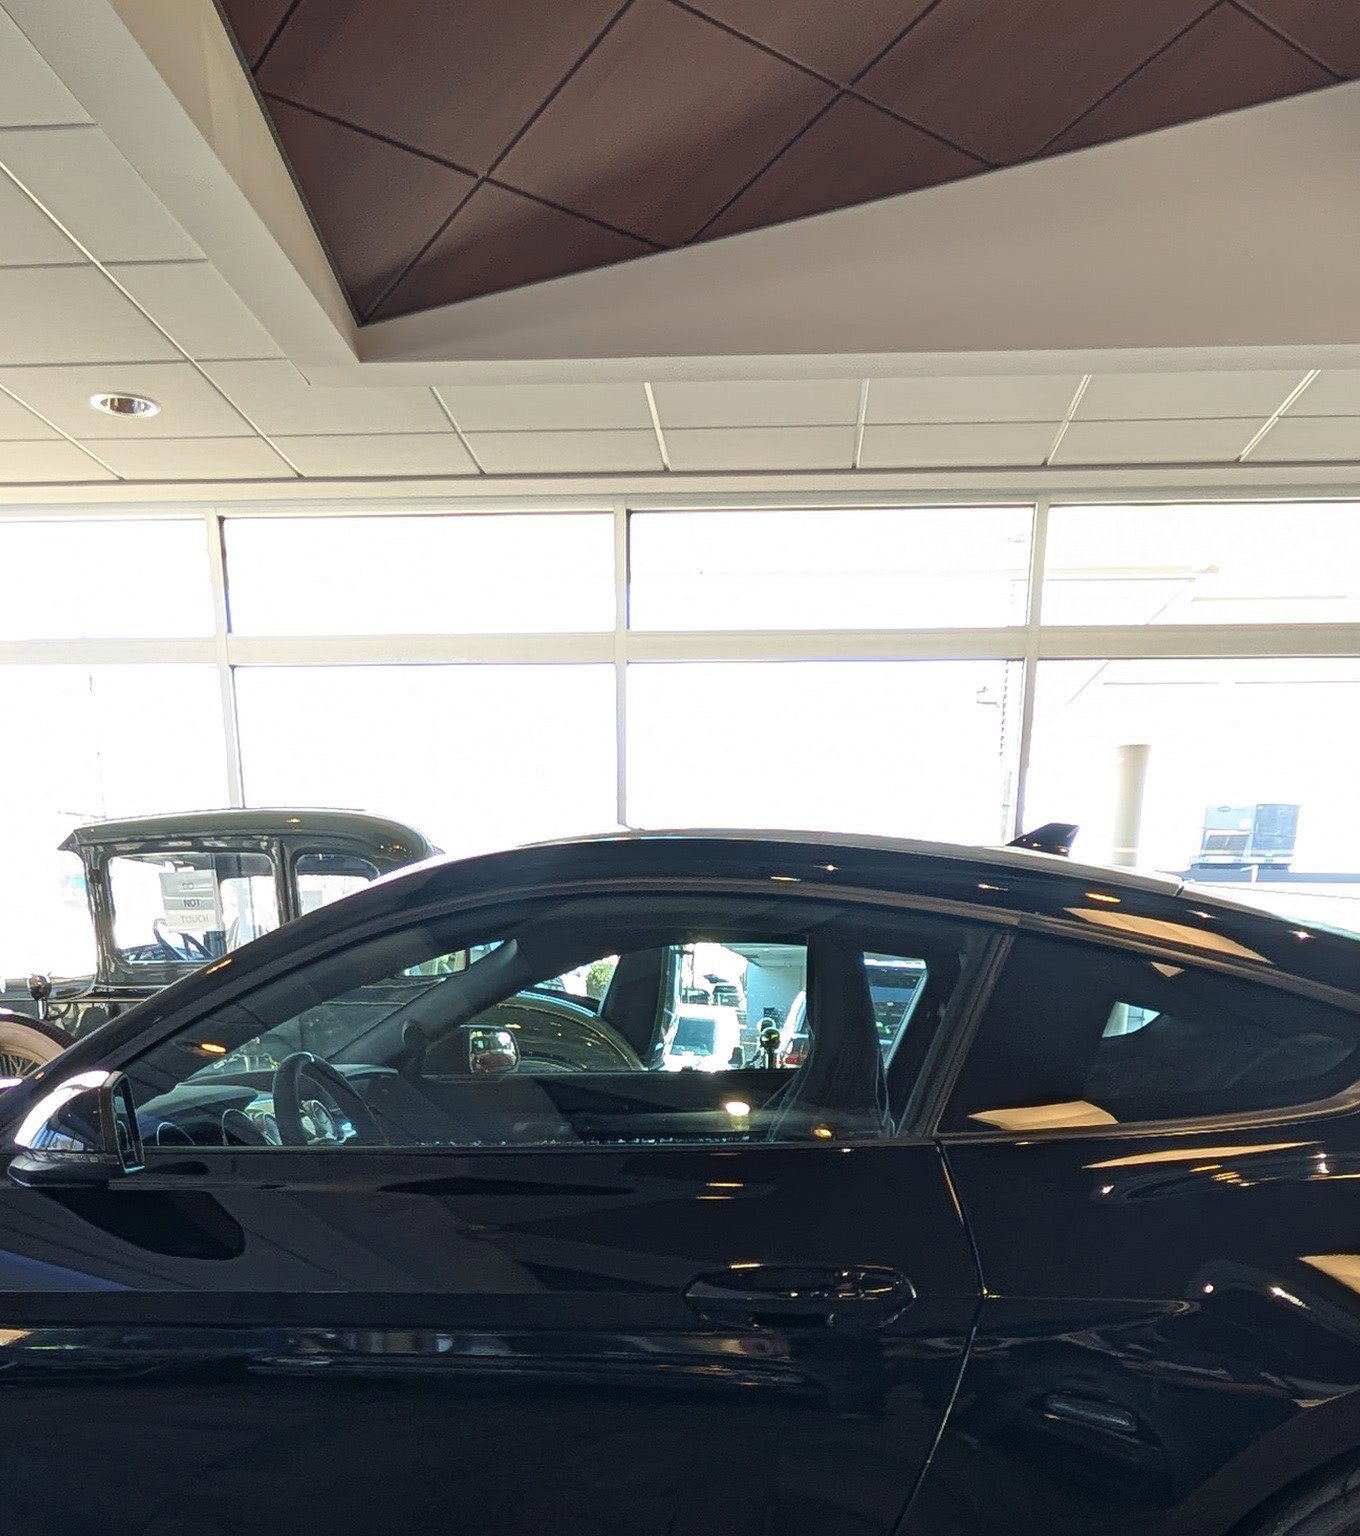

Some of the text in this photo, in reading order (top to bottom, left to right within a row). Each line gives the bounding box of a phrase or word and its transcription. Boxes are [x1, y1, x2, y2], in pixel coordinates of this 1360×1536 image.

[181, 882, 195, 890] DO
[183, 899, 200, 907] NOT
[180, 915, 209, 924] TOUCH
